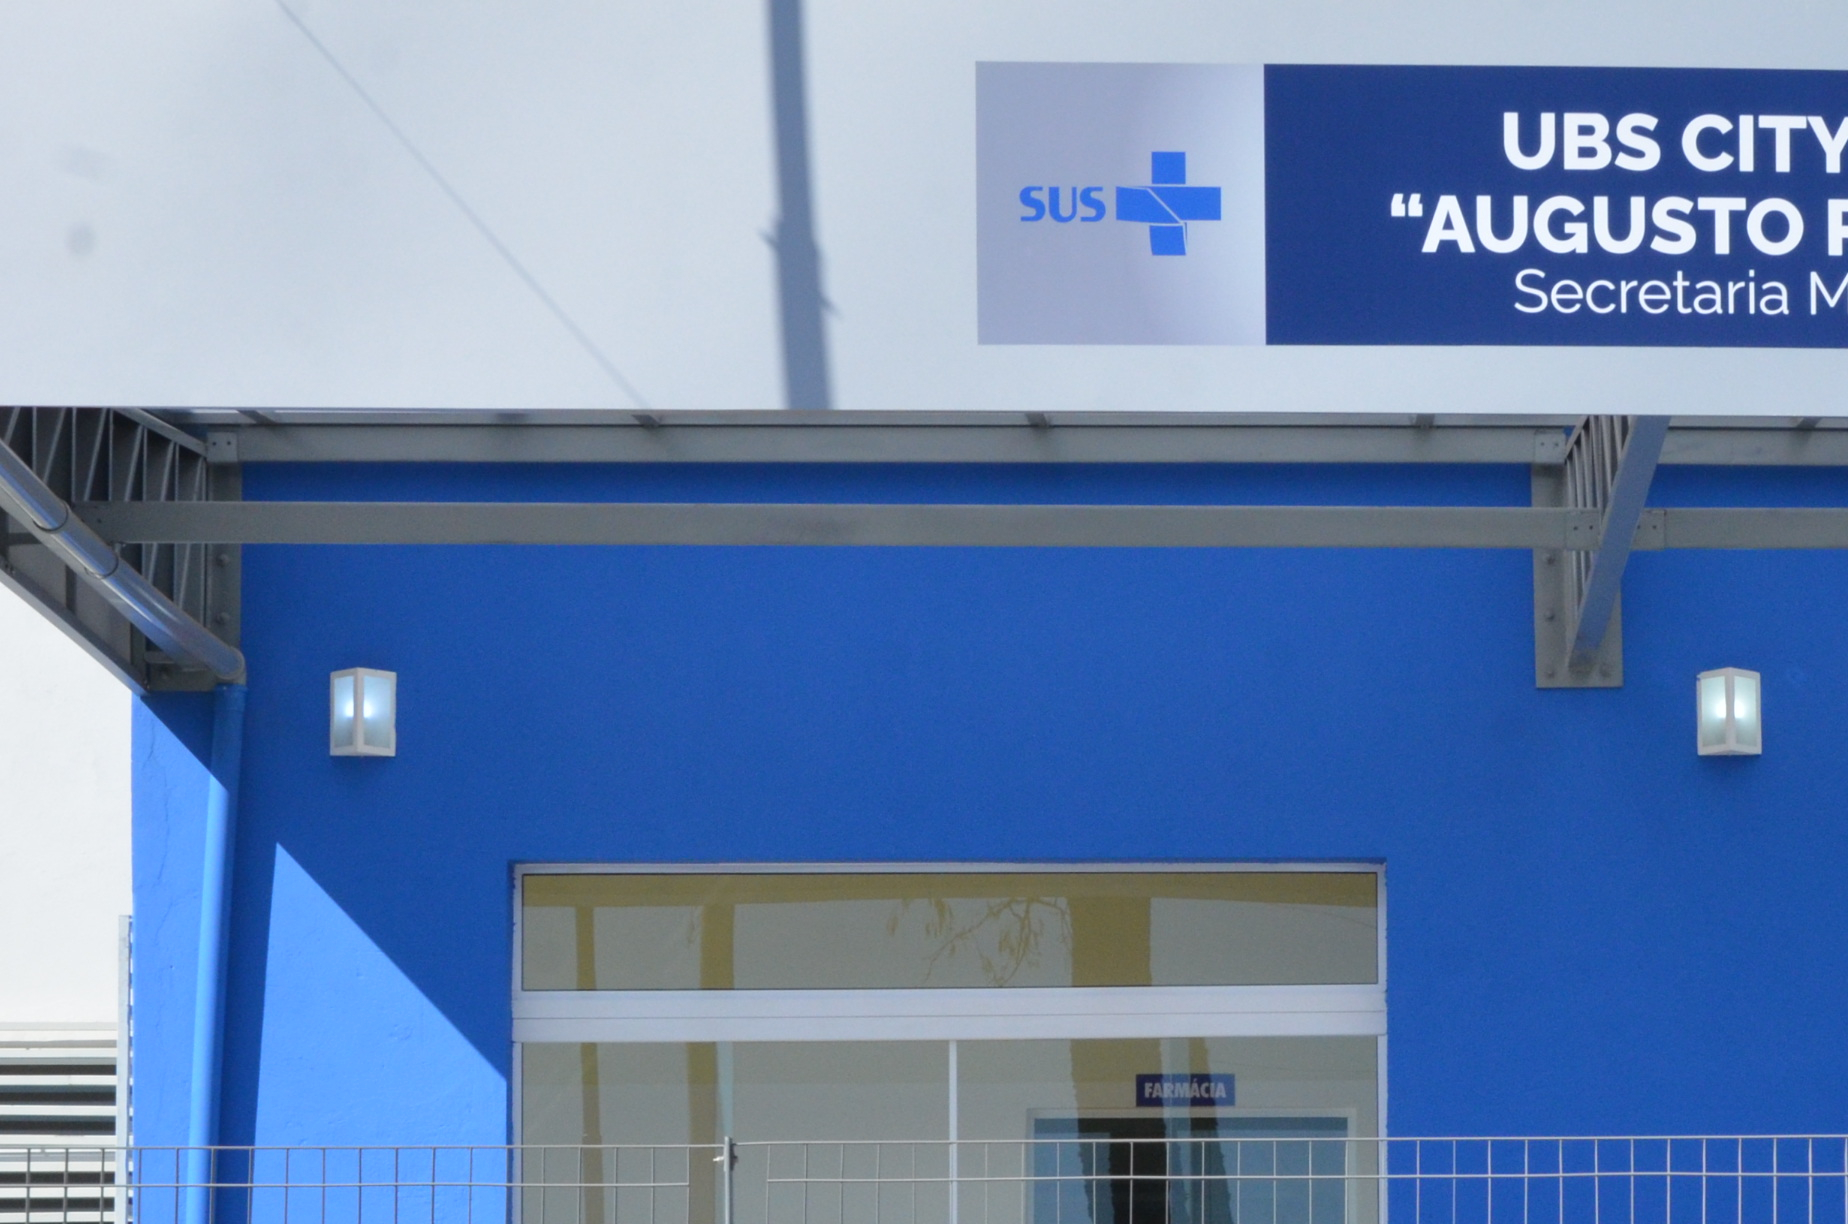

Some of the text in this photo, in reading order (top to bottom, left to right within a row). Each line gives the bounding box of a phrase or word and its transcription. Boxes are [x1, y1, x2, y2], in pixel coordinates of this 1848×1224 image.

[1503, 111, 1661, 172] UBS
[1019, 185, 1107, 224] SUS
[1514, 268, 1790, 316] Secretaria
[1144, 1078, 1227, 1098] FARMÁCIA
